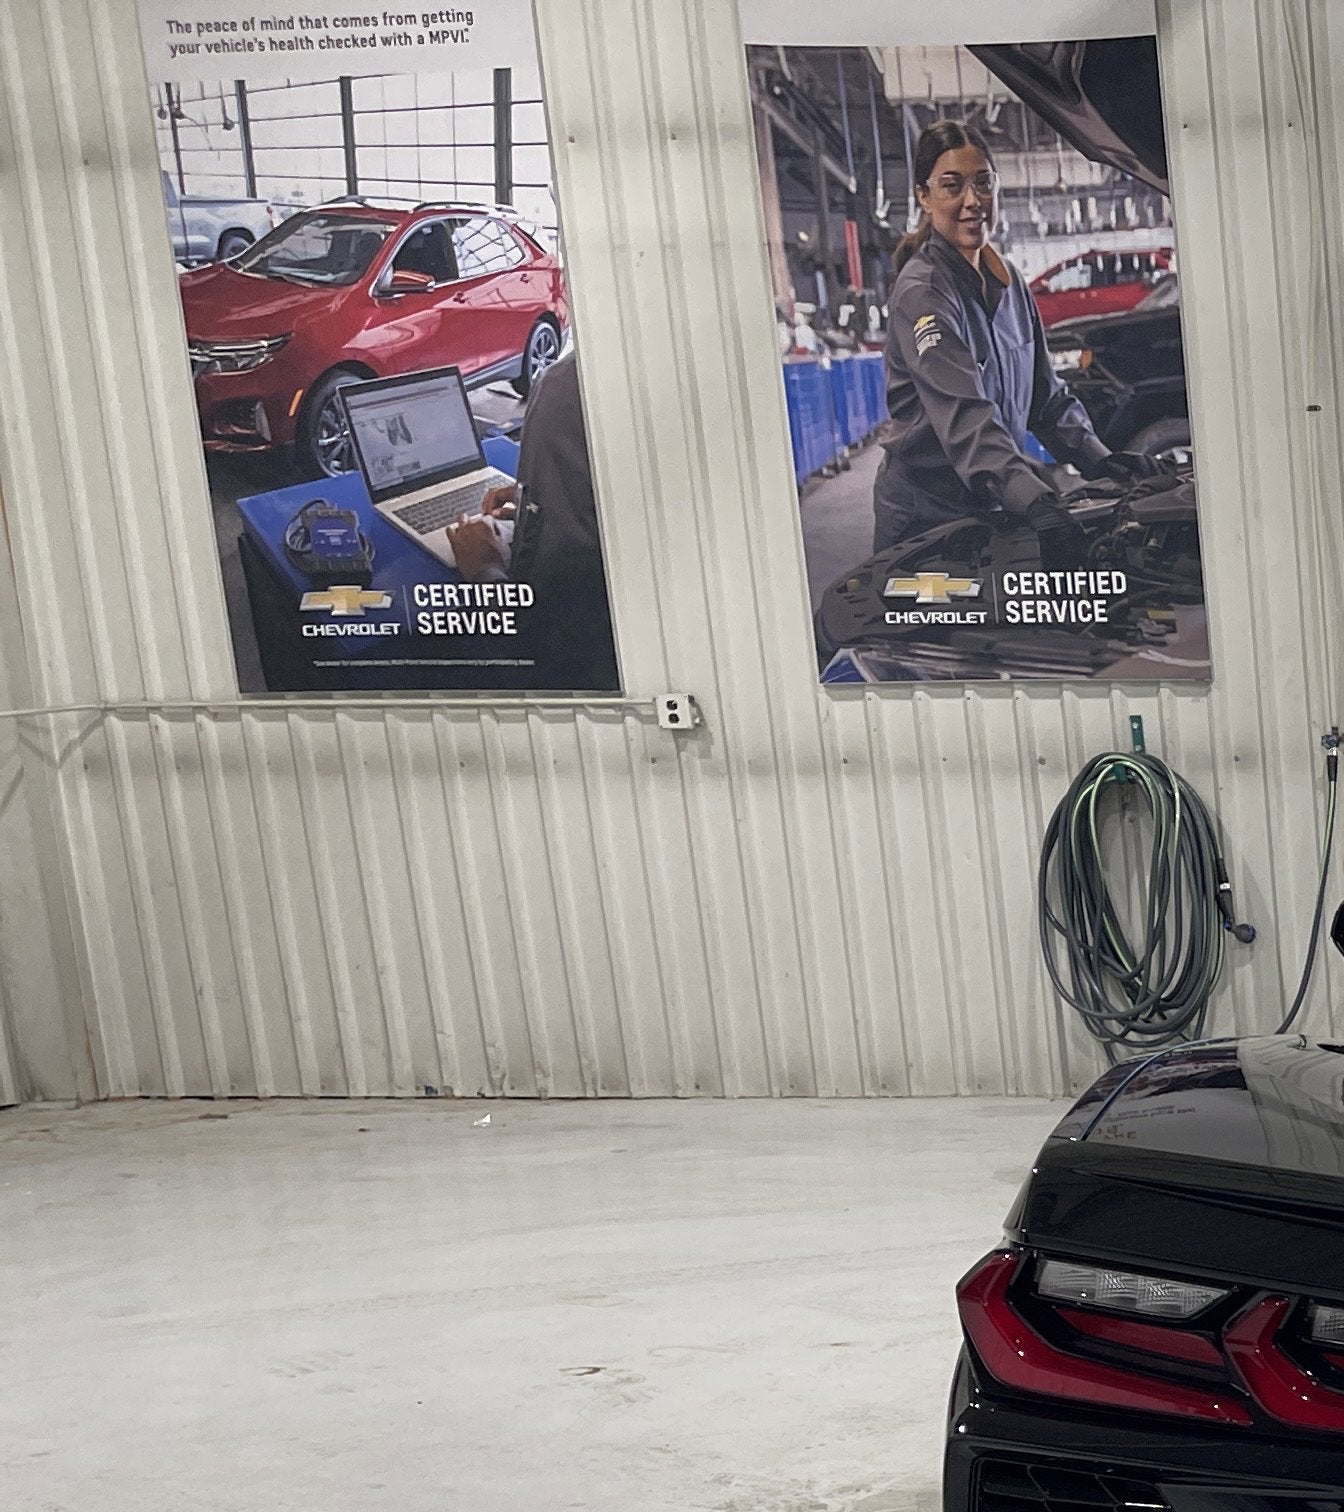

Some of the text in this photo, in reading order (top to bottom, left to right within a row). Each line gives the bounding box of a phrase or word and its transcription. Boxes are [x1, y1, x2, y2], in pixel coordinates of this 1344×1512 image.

[166, 8, 474, 37] The peace of mind that comes from getting
[169, 43, 201, 59] your
[205, 37, 266, 54] vehicle's
[268, 35, 315, 52] health
[318, 33, 377, 50] checked
[380, 31, 413, 47] with
[416, 34, 425, 45] a
[413, 583, 535, 609] CERTIFIED
[1002, 570, 1128, 596] CERTIFIED
[416, 610, 518, 636] SERVICE
[884, 610, 989, 626] CHEVROLET
[1004, 599, 1109, 624] SERVICE
[301, 621, 402, 638] CHEVROLET
